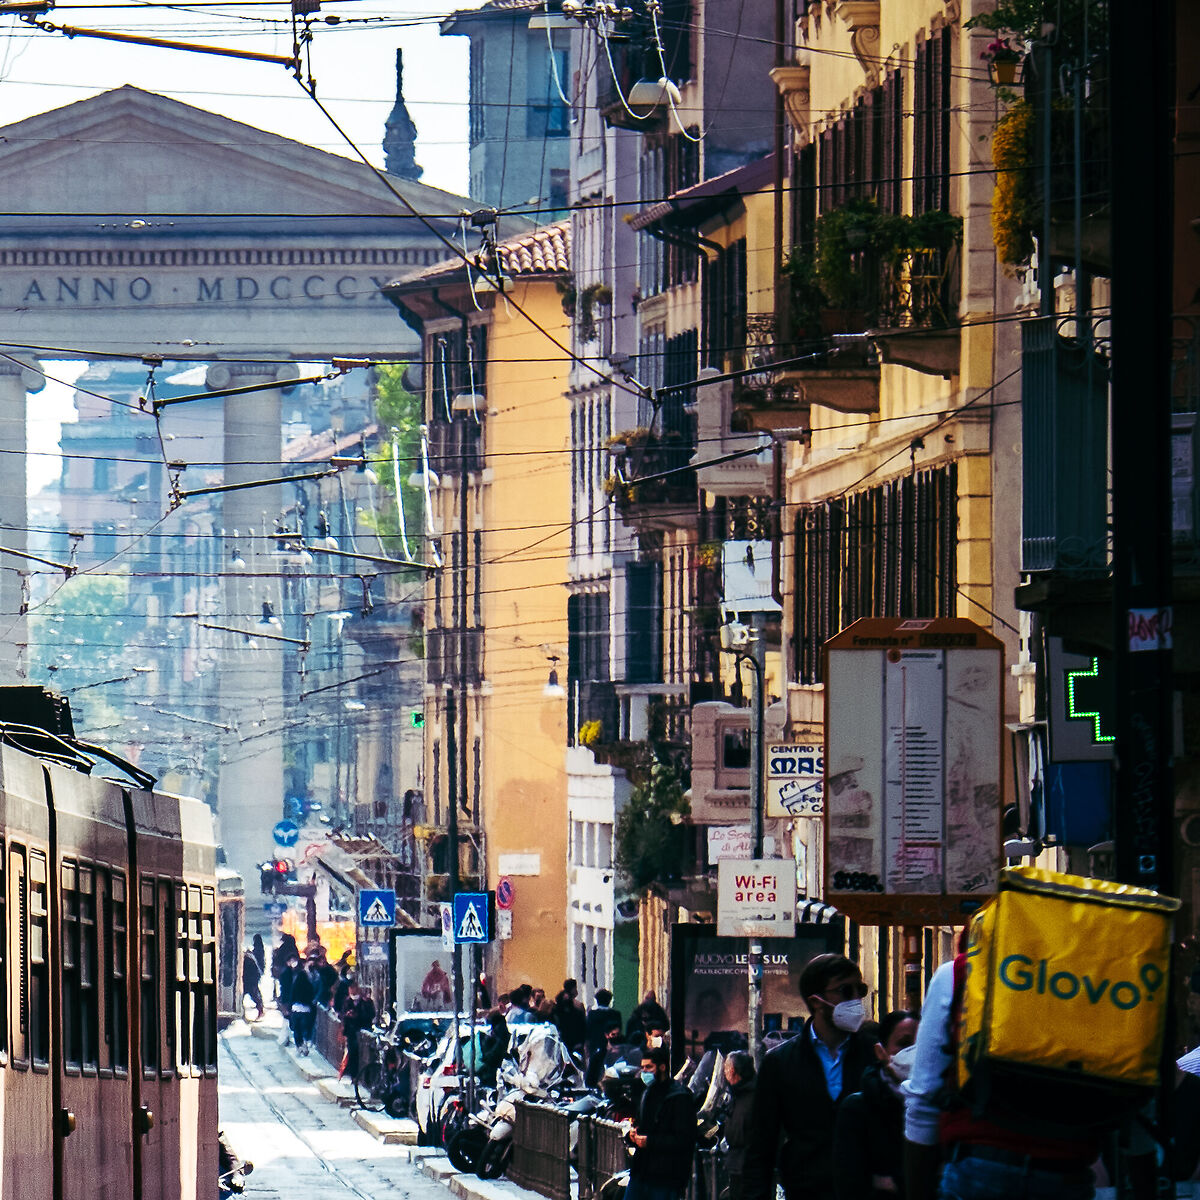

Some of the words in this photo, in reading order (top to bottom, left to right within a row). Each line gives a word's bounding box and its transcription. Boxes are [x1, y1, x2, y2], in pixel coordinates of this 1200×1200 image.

[23, 276, 152, 301] ANNO
[853, 635, 899, 646] Fermata
[771, 745, 814, 754] CENTRO
[802, 795, 824, 804] Fer
[735, 875, 777, 890] Wi-Fi
[735, 892, 777, 902] area
[694, 954, 735, 965] NUOVO
[735, 954, 770, 965] LES
[772, 954, 788, 965] UX
[999, 954, 1142, 1011] Glovo
